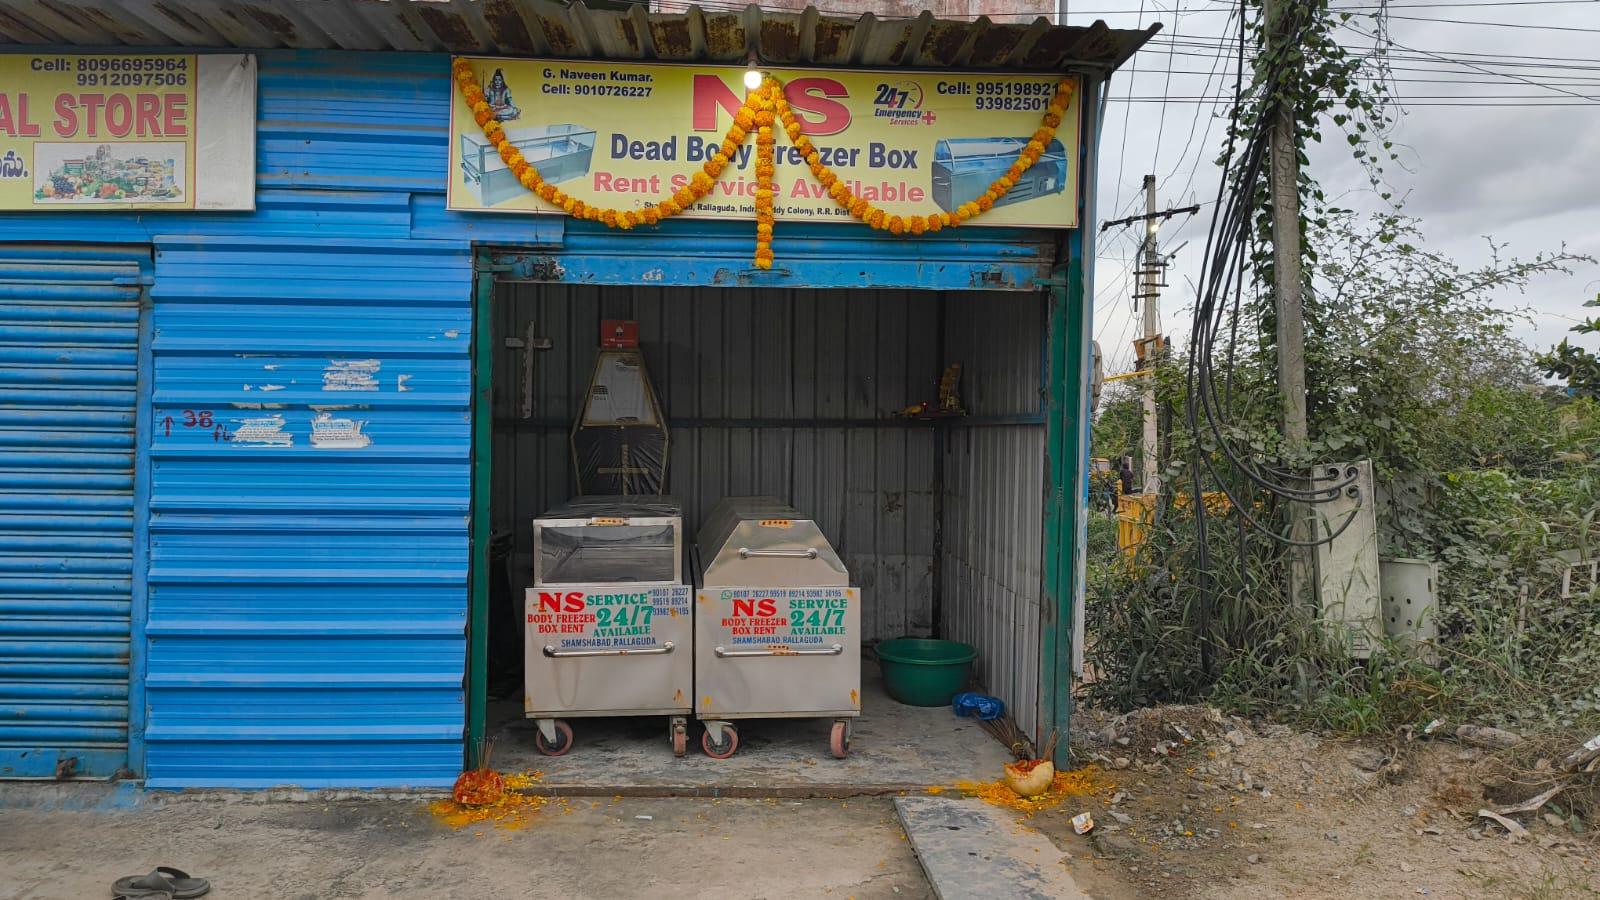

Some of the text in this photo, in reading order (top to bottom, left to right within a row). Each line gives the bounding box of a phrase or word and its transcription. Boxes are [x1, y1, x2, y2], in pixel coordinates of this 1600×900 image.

[31, 58, 187, 71] Cell: 8096695964
[77, 73, 187, 86] 9912097506
[543, 68, 653, 82] G. Naveen Kumar.
[542, 84, 652, 97] Cell: 9010726227
[936, 82, 1060, 95] Cell: 995198921
[692, 74, 852, 137] NS
[976, 97, 1049, 111] 93982501
[53, 93, 188, 138] STORE
[874, 108, 922, 118] Emergency
[889, 118, 919, 126] Services
[611, 134, 918, 170] Dead Boy rezer Box
[594, 172, 925, 202] Rent Svic Avilable
[787, 207, 815, 217] Colony,
[817, 208, 833, 216] R.R.
[183, 409, 213, 427] 38
[538, 592, 585, 612] NS
[586, 593, 648, 606] SERVICE
[789, 598, 847, 609] SERVICE
[732, 599, 777, 617] NS
[527, 614, 595, 623] BODY FREEZER
[596, 605, 654, 627] 24/7
[721, 618, 787, 626] BODY FREEZER
[790, 609, 845, 626] 24/7
[538, 624, 584, 633] BOX RENT
[593, 626, 651, 637] AVAILABLE
[732, 627, 776, 635] BOX RENT
[790, 626, 846, 636] AVAILABLE
